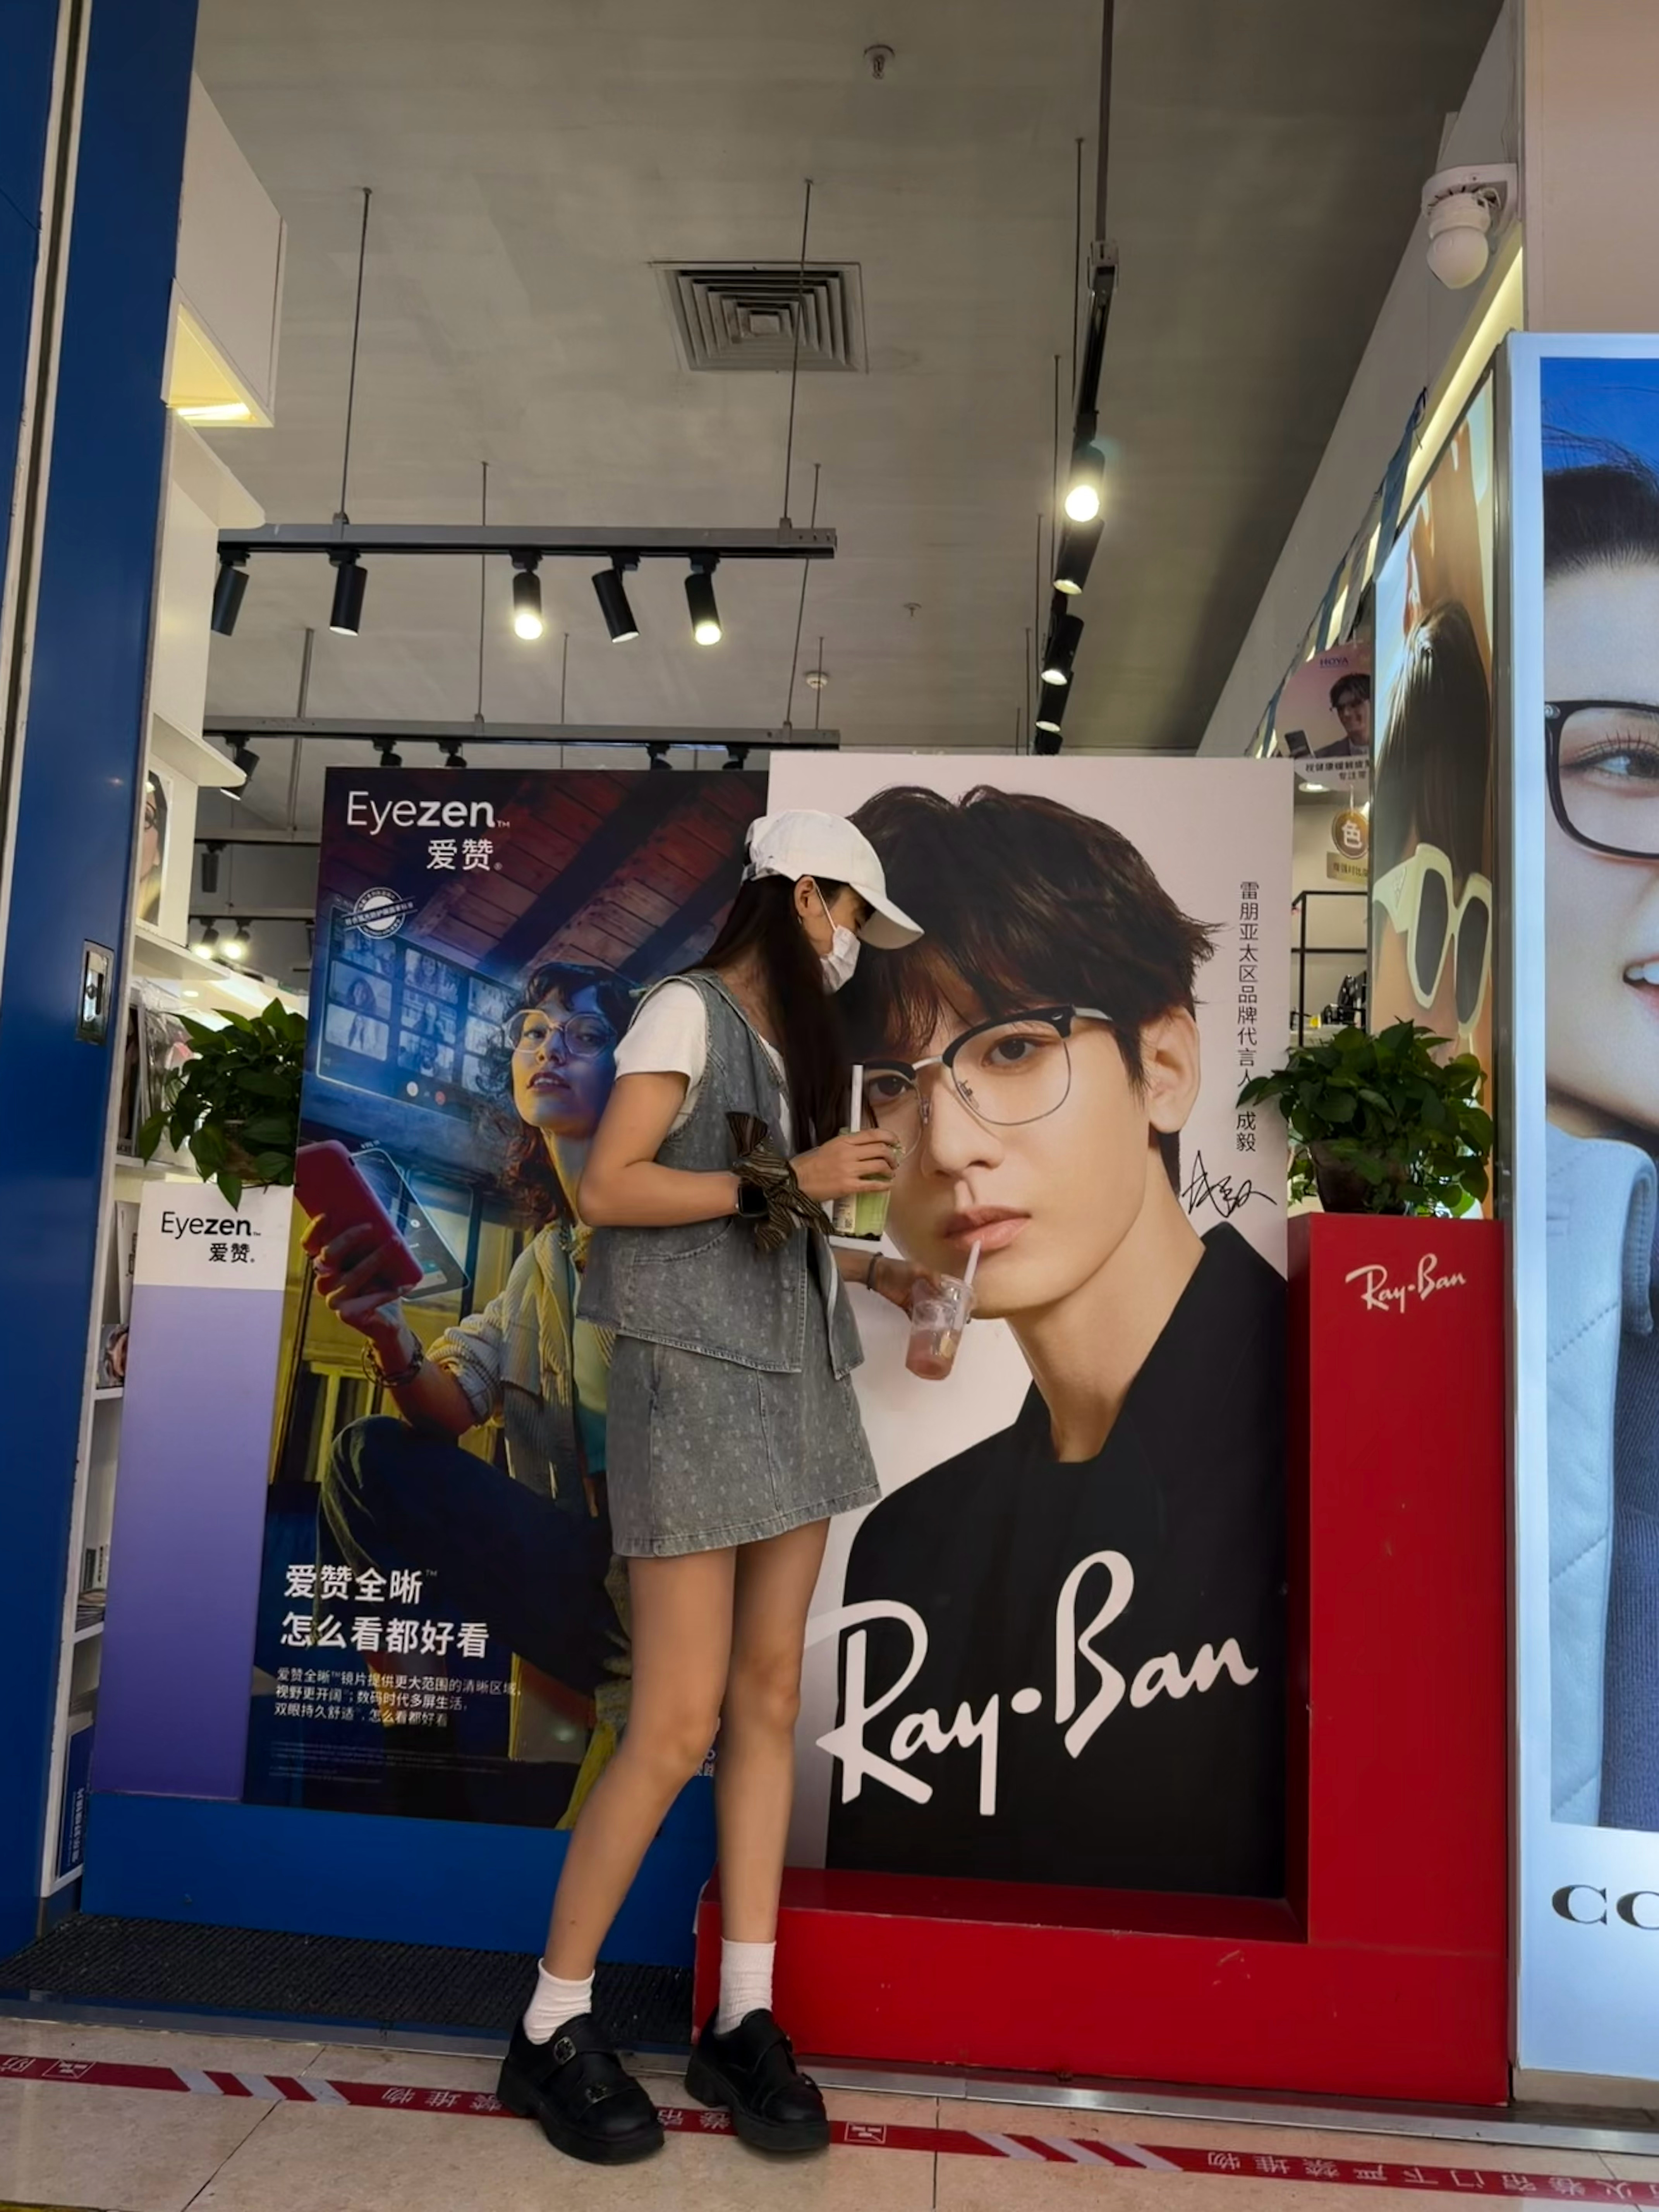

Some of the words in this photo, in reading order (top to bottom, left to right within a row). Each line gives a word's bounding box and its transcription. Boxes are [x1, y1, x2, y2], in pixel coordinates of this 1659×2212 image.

[1341, 821, 1363, 849] 色
[280, 1611, 489, 1658] 怎么看都好看
